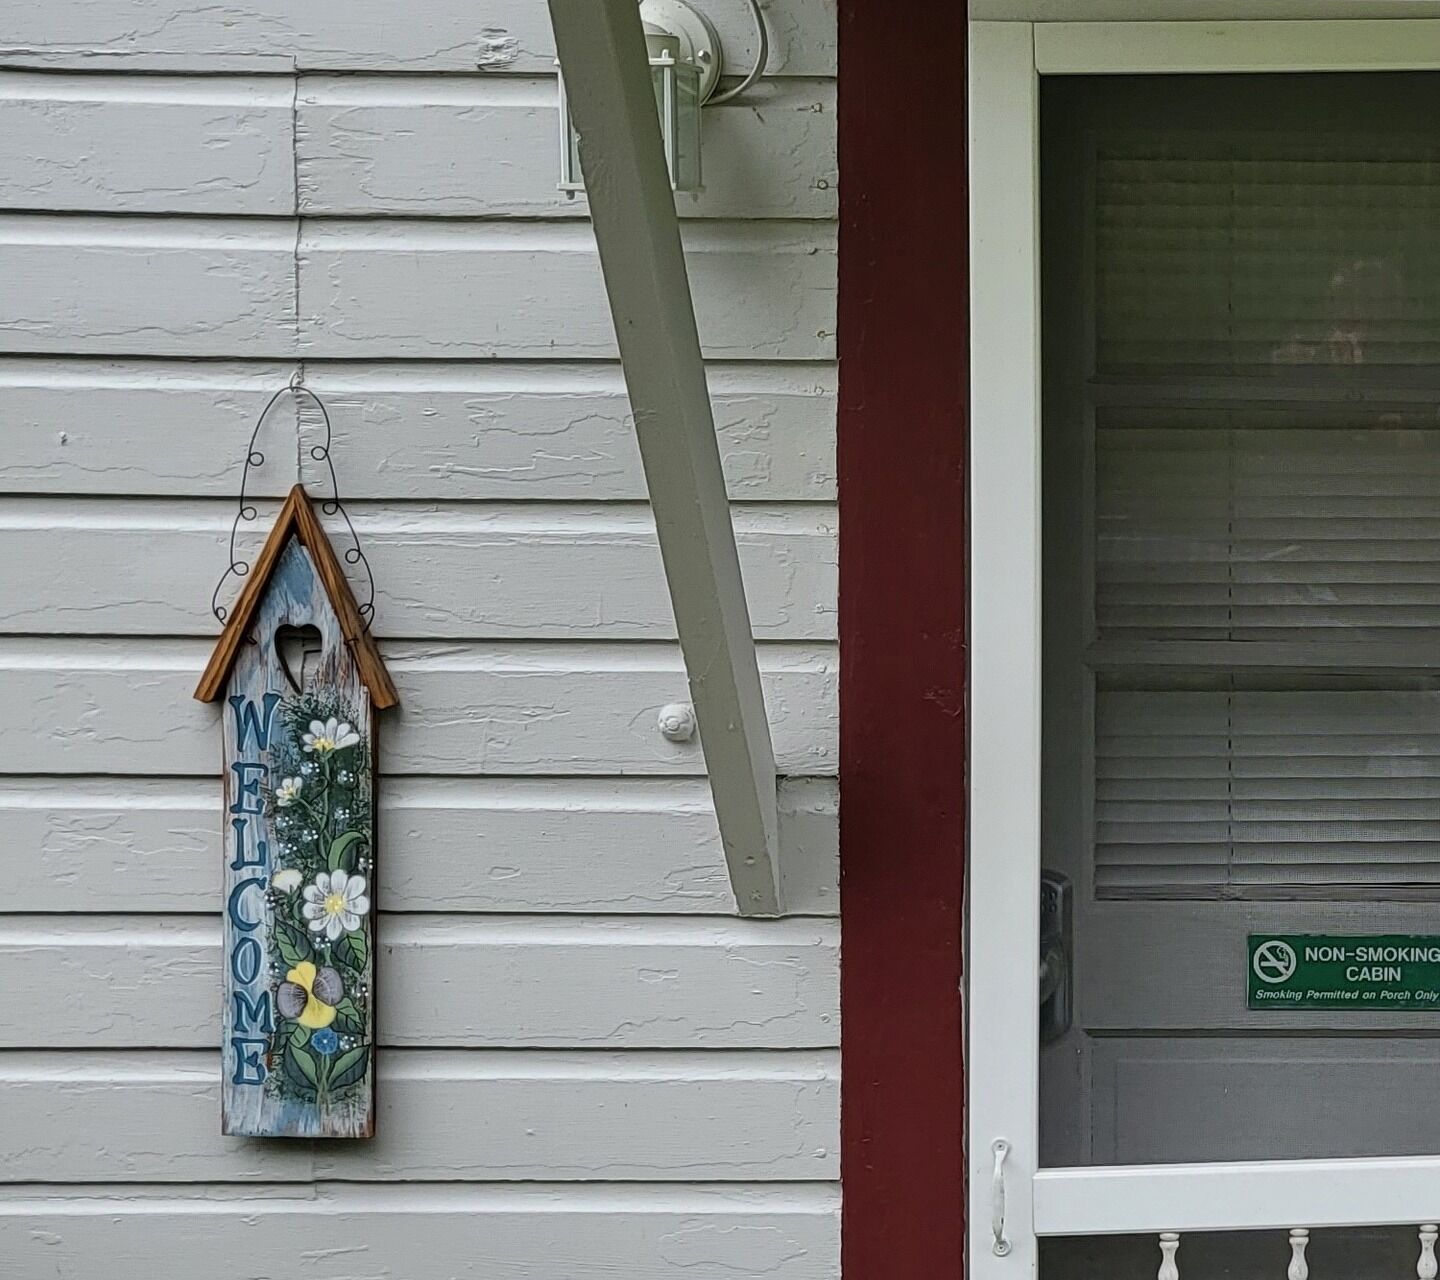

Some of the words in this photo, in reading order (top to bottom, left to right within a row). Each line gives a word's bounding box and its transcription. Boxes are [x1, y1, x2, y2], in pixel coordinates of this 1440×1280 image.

[228, 694, 281, 1086] WELCOME
[1345, 966, 1402, 982] CABIN
[1255, 989, 1303, 1001] Smoking
[1306, 989, 1359, 1001] Permitted
[1362, 990, 1376, 1000] on
[1380, 990, 1411, 1001] Porch
[1414, 990, 1440, 1002] Only
